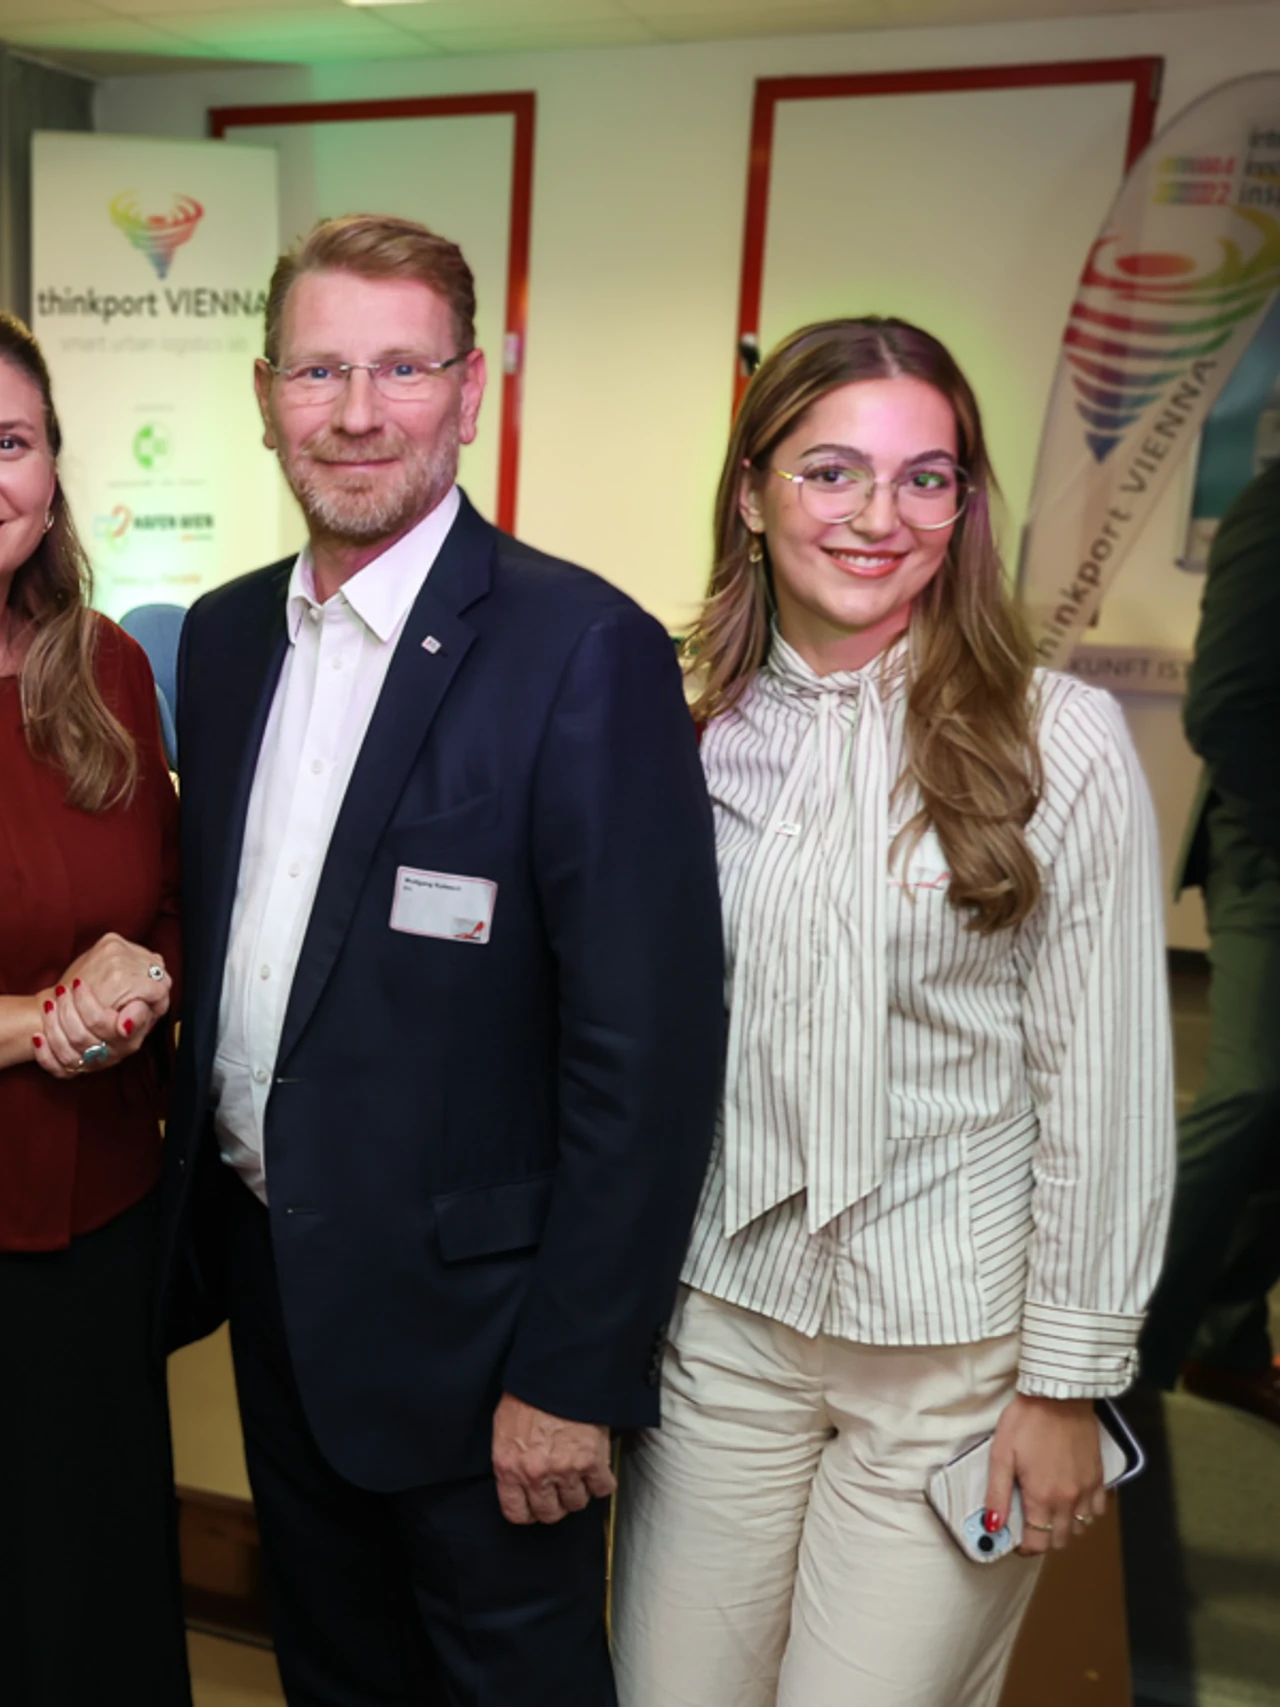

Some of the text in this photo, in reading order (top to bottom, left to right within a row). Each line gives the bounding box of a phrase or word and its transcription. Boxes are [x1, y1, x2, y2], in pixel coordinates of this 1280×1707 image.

[37, 284, 268, 324] thinkport VIENNA
[1035, 356, 1219, 660] hinkport VIENNA
